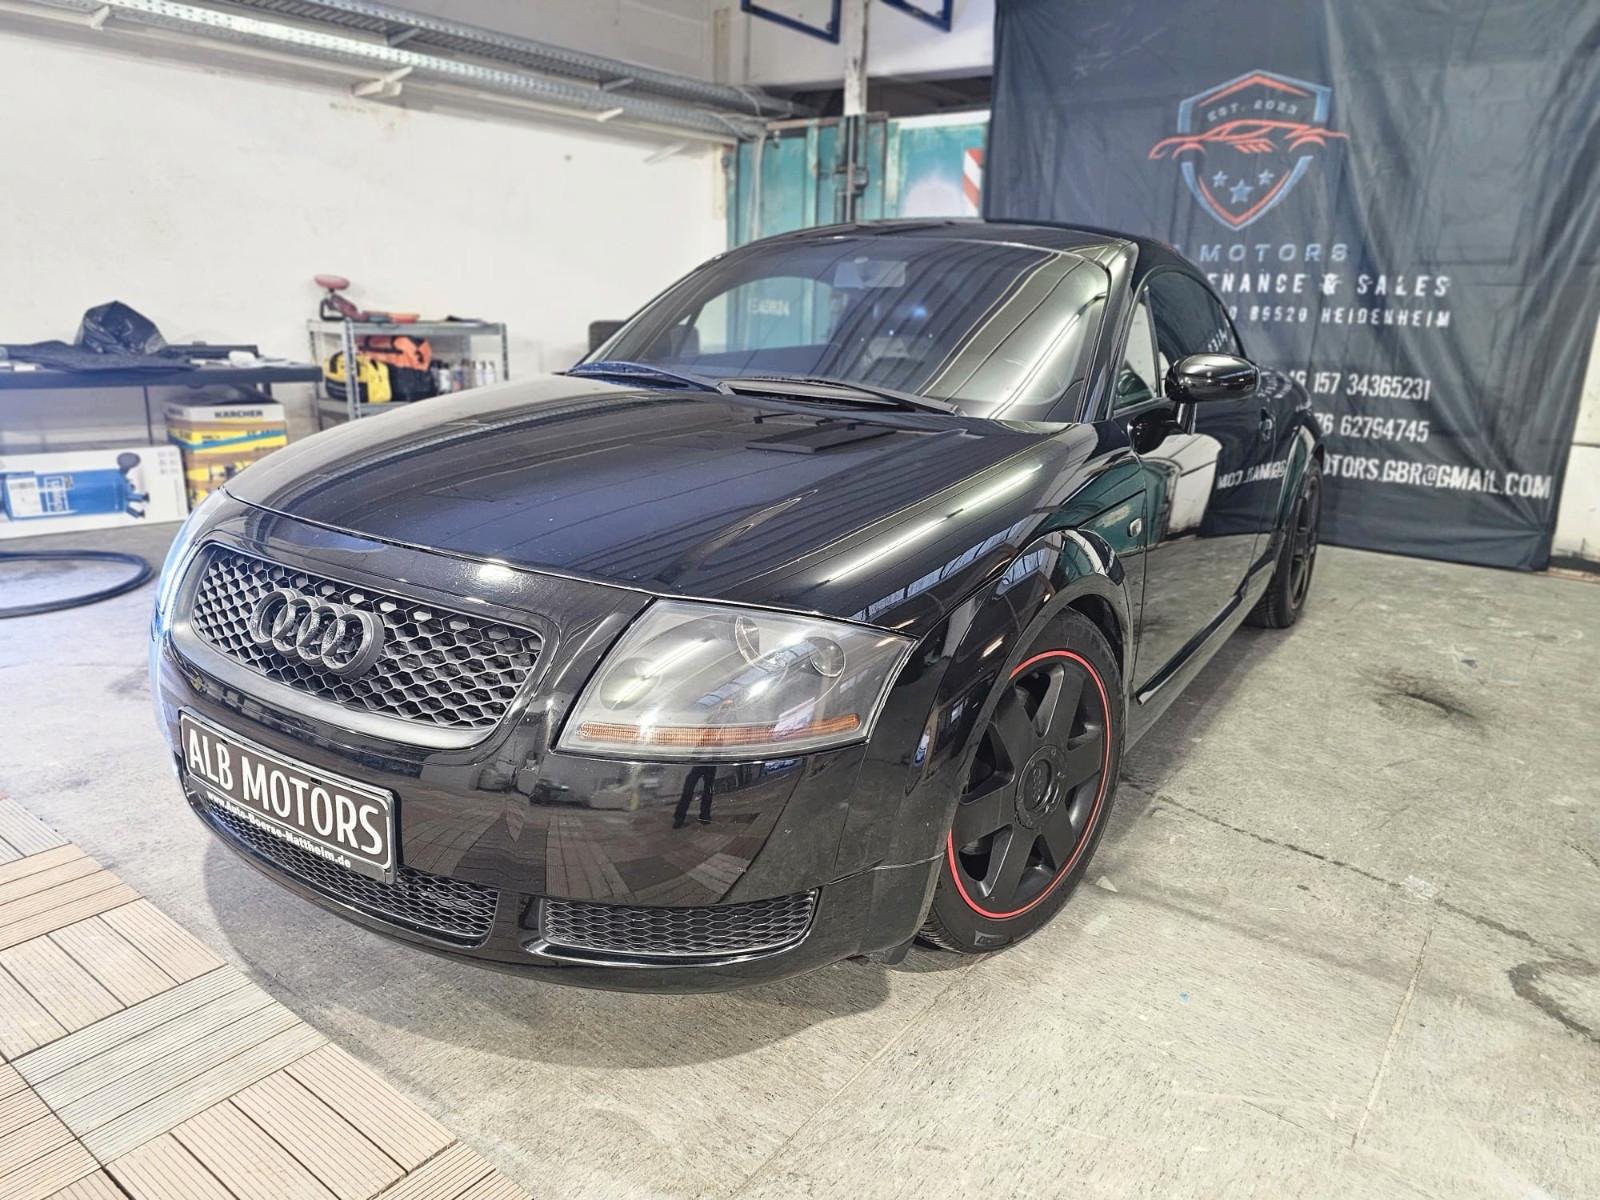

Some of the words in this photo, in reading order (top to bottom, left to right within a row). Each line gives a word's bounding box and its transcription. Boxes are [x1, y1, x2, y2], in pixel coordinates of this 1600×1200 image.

[1200, 243, 1348, 262] MOTORS
[1322, 272, 1340, 295] &
[1357, 273, 1449, 297] SALES
[1320, 307, 1451, 328] HEIDENHEIM
[1313, 372, 1341, 394] 157
[1346, 373, 1431, 401] 34365231
[1340, 415, 1429, 443] 62794745
[189, 728, 234, 791] ALB
[241, 755, 384, 855] MOTORS
